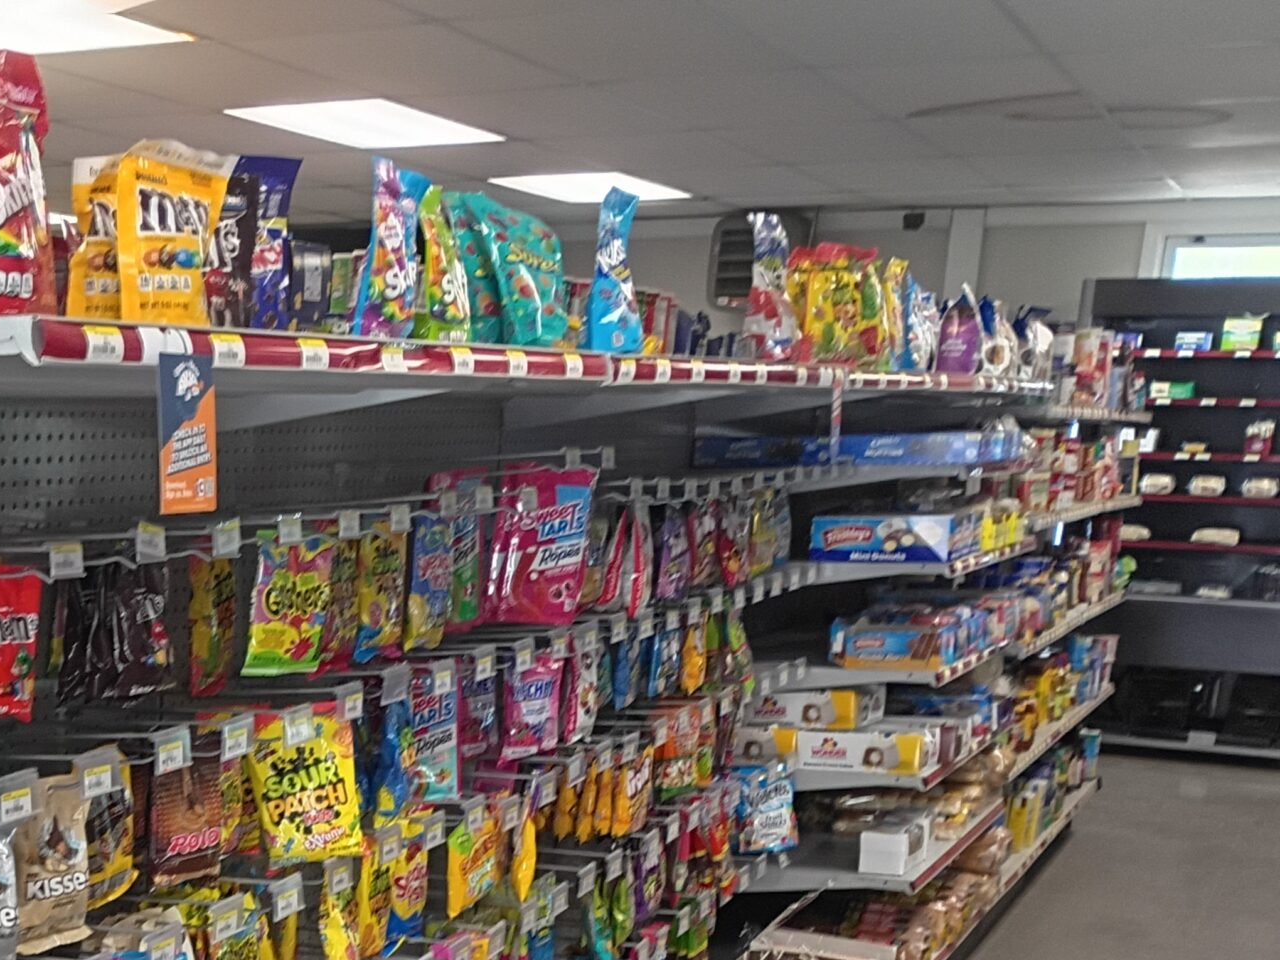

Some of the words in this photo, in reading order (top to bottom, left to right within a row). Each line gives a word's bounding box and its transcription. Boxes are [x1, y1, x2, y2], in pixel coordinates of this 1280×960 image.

[539, 547, 582, 569] Ropes
[263, 761, 338, 799] SOUR
[269, 780, 348, 824] PATCH
